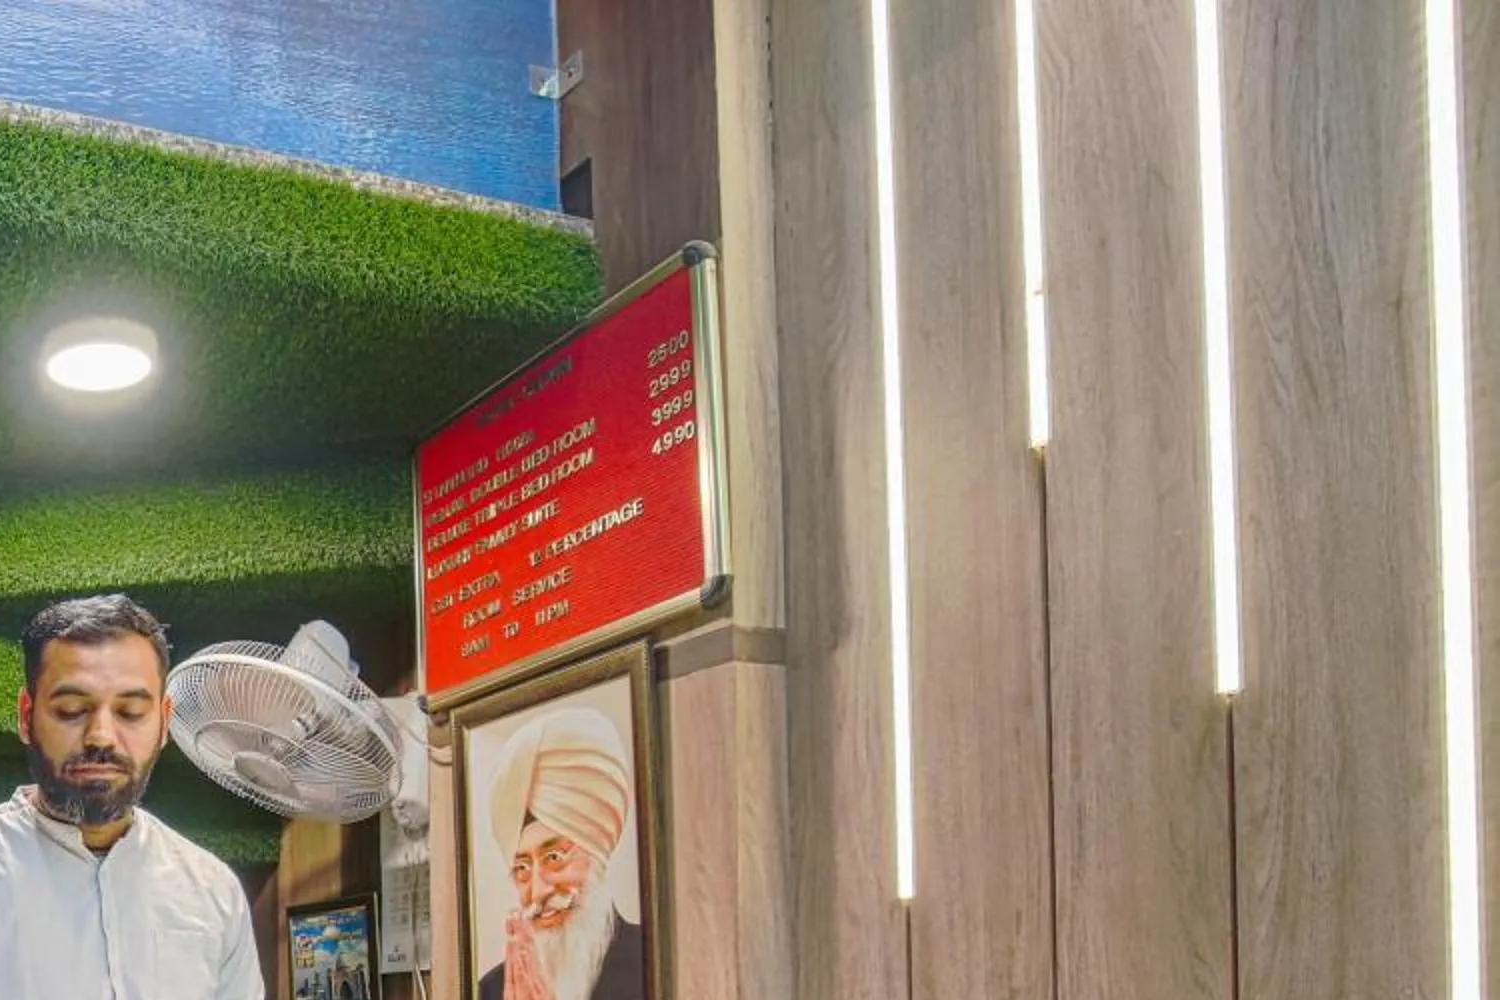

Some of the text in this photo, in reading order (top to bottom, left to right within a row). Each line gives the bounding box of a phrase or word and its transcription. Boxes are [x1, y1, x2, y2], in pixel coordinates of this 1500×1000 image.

[469, 466, 521, 504] DOUBLE
[520, 444, 550, 474] BED
[553, 416, 597, 456] ROOM
[649, 359, 691, 399] 2999
[472, 489, 521, 527] TRIPLE
[520, 473, 550, 502] BED
[551, 447, 595, 486] ROOM
[651, 388, 693, 428] 3999
[519, 497, 561, 532] SUITE
[651, 420, 695, 456] 4990
[458, 569, 501, 602] EXTRA
[545, 495, 645, 559] PERCENTAGE
[463, 564, 575, 630] ROOM SERVICE
